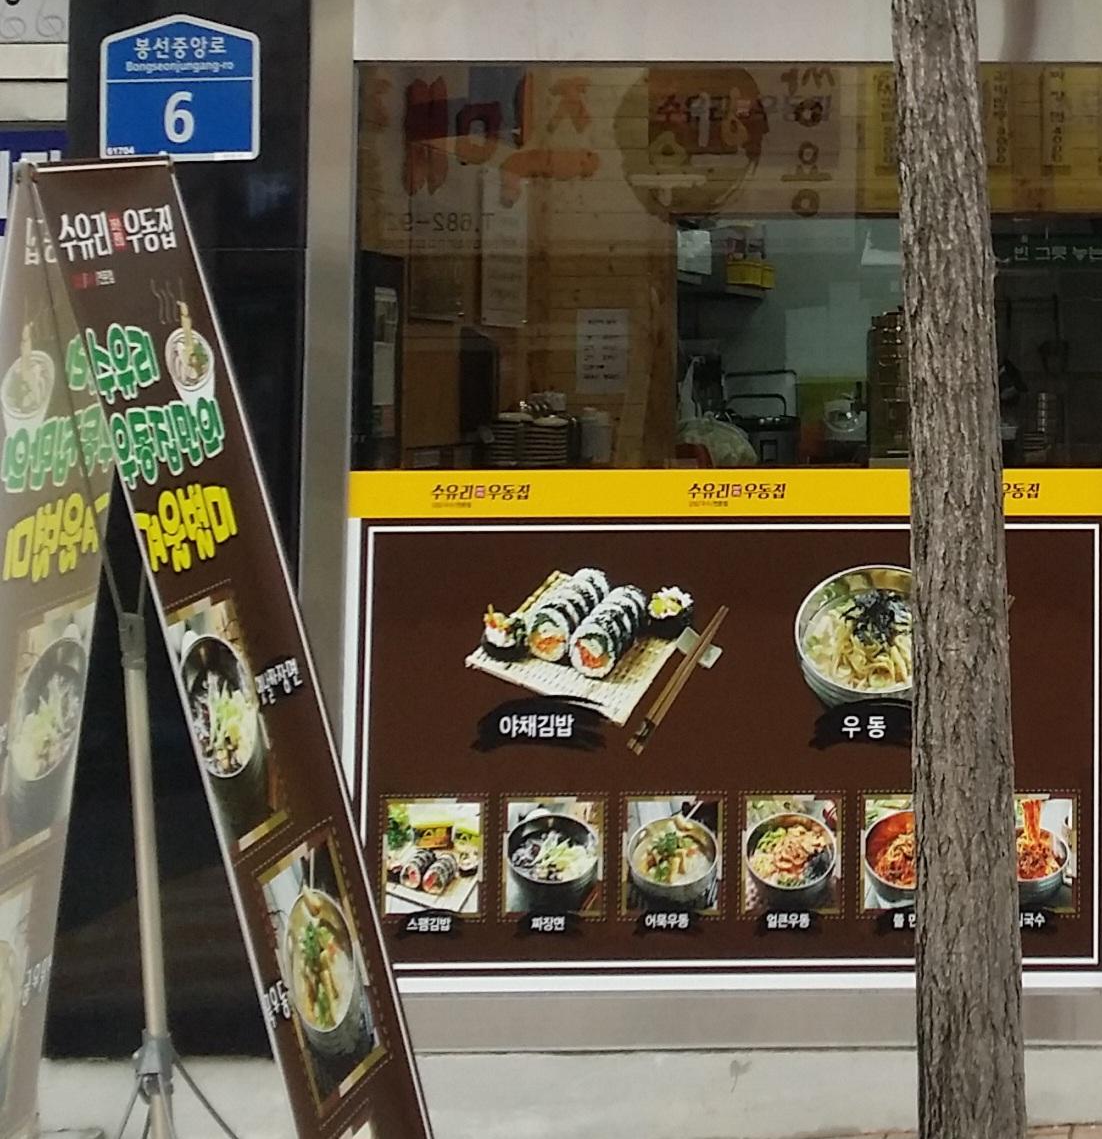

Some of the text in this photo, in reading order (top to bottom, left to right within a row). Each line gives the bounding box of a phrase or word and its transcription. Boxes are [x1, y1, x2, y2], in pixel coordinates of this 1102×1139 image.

[133, 36, 227, 60] 봉선중앙로
[125, 60, 234, 73] Bongseonjungang-ro
[163, 91, 195, 143] 6
[59, 212, 113, 262] 수유리
[123, 205, 177, 254] 우동집
[431, 484, 474, 501] 수유리
[487, 484, 531, 501] 우동집
[687, 483, 731, 500] 수유리
[743, 483, 787, 500] 우동집
[499, 714, 574, 738] 야채김밥
[530, 915, 566, 931] 짜장면
